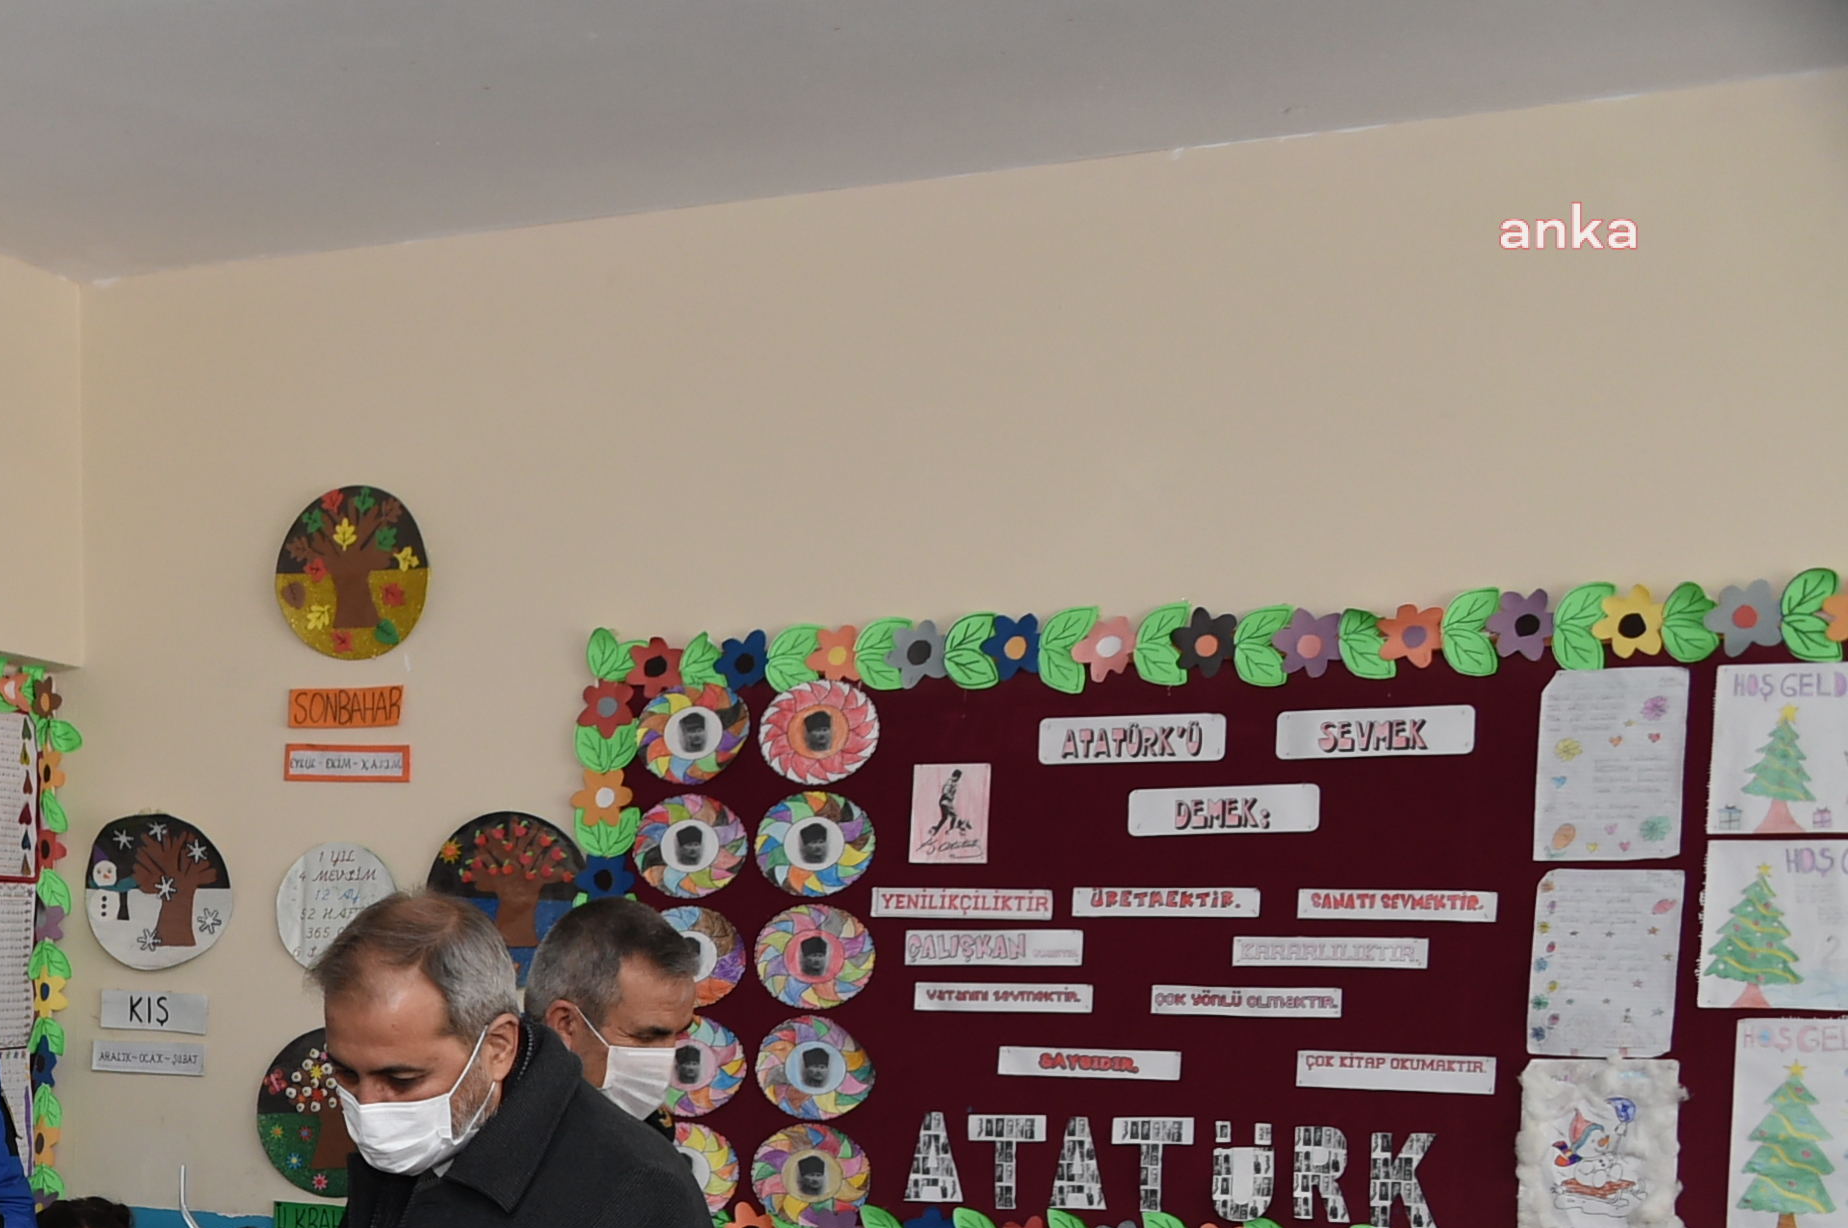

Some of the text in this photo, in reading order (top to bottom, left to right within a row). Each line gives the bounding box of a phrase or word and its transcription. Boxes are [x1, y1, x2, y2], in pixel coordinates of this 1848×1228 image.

[1733, 672, 1774, 702] HOŞ
[294, 686, 402, 725] SONBAHAR
[1061, 720, 1203, 759] ATATÜRK'Ü
[1318, 719, 1428, 752] SEVMEK
[1174, 797, 1270, 829] DEMEK;
[300, 908, 316, 920] 52
[881, 888, 1050, 916] YENİLİKÇİLİKTİR
[1310, 892, 1377, 910] SANATI
[306, 926, 330, 939] 365
[907, 933, 1027, 963] ÇALIŞKAN
[129, 995, 169, 1027] KIŞ
[1305, 1055, 1335, 1071] ÇOK
[1339, 1052, 1386, 1070] KİTAP
